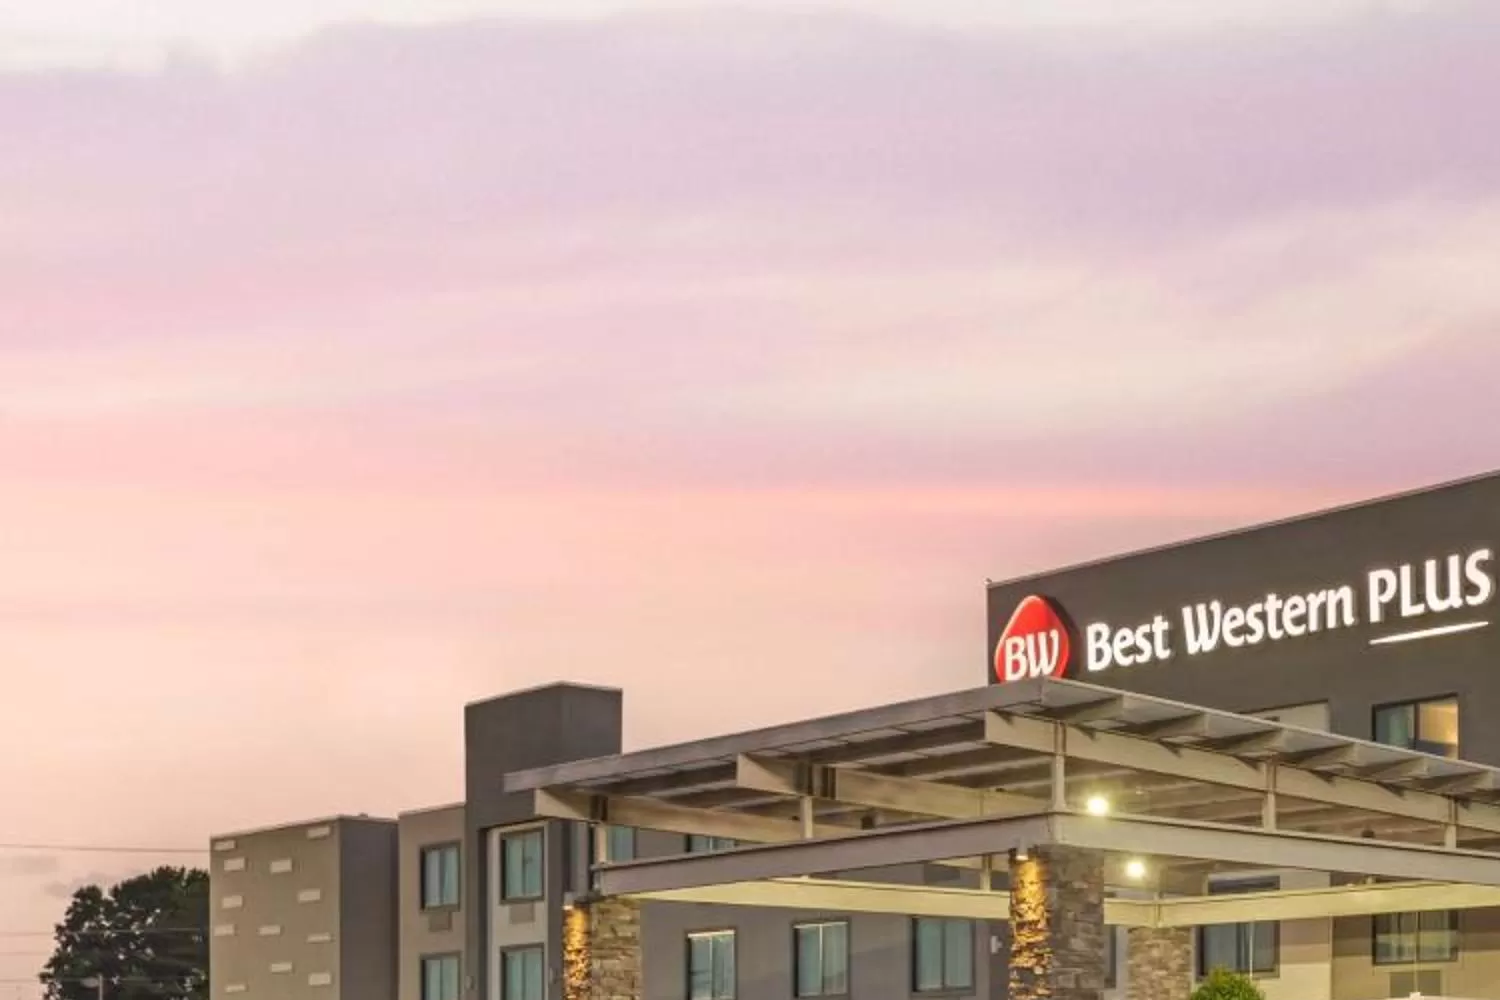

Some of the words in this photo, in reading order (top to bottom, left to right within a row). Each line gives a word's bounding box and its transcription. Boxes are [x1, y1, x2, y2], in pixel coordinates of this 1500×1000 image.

[1086, 614, 1171, 672] Best
[1182, 584, 1355, 655] Western
[1367, 548, 1492, 624] PLUS
[1004, 629, 1060, 681] BW
